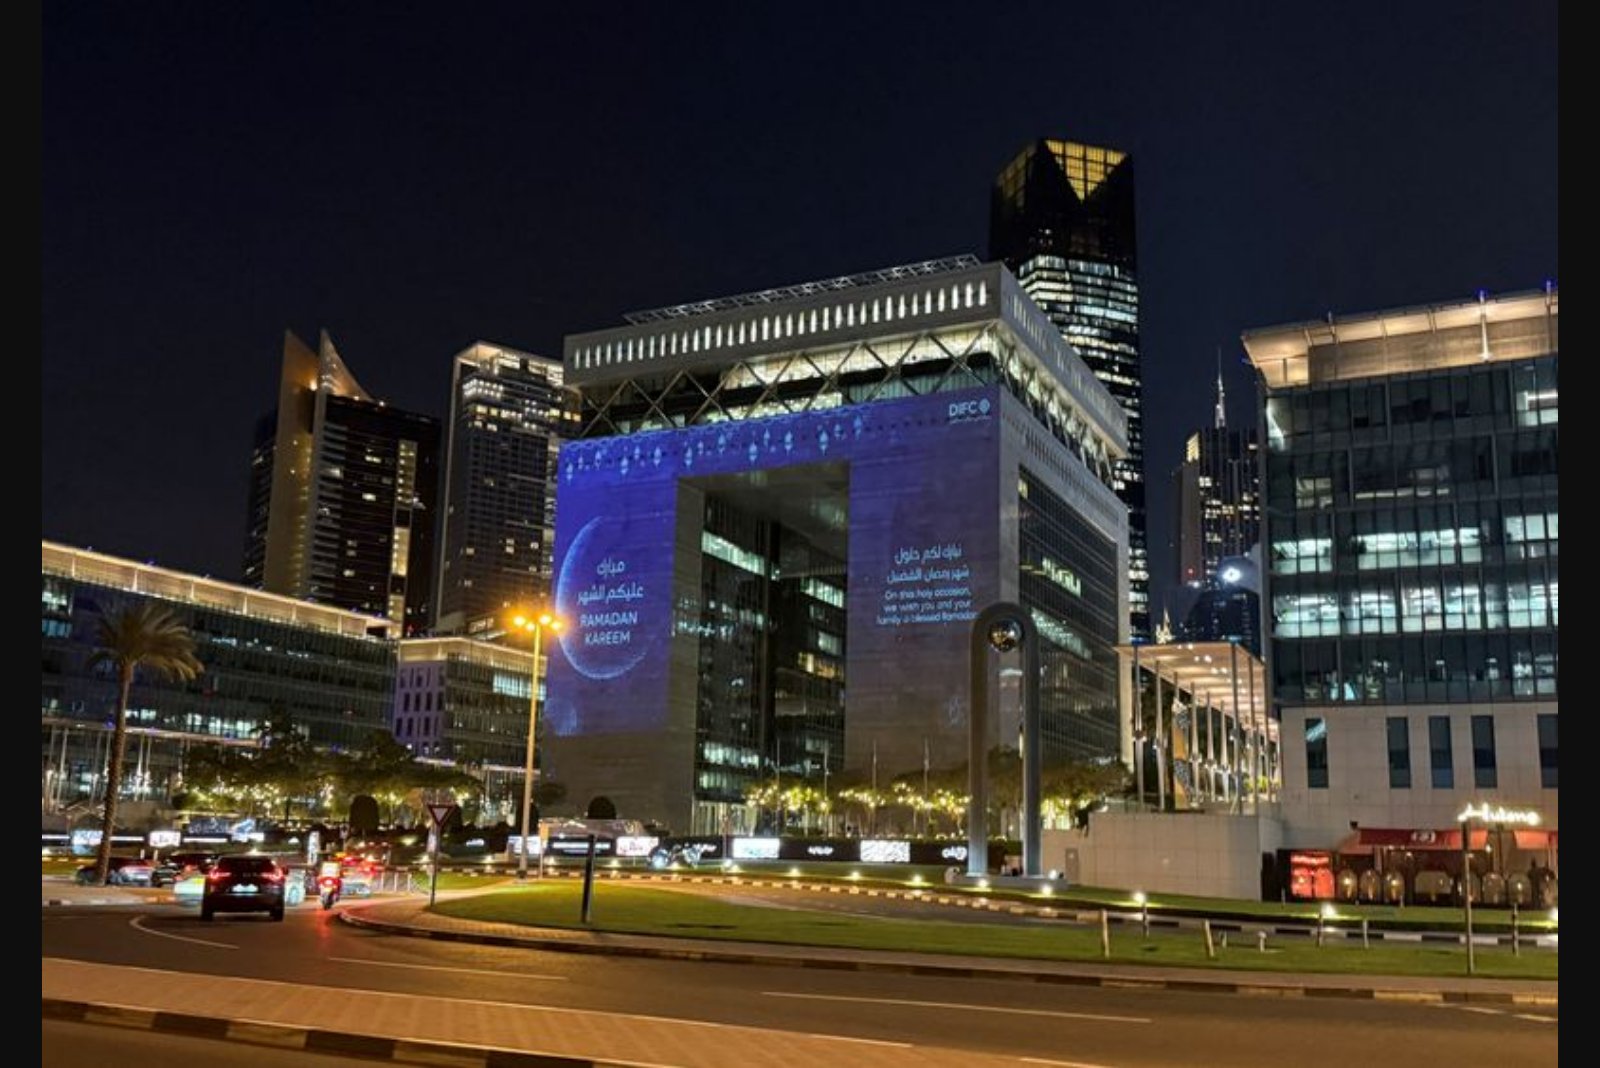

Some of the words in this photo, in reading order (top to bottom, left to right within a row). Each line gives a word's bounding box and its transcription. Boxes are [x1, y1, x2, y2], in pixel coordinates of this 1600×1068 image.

[949, 401, 978, 416] DIFC
[597, 556, 625, 578] مبارك
[577, 584, 605, 606] الشهر
[605, 581, 644, 604] عليكم
[884, 590, 897, 600] On
[580, 611, 638, 626] RAMADAN
[585, 631, 631, 645] KAREEM
